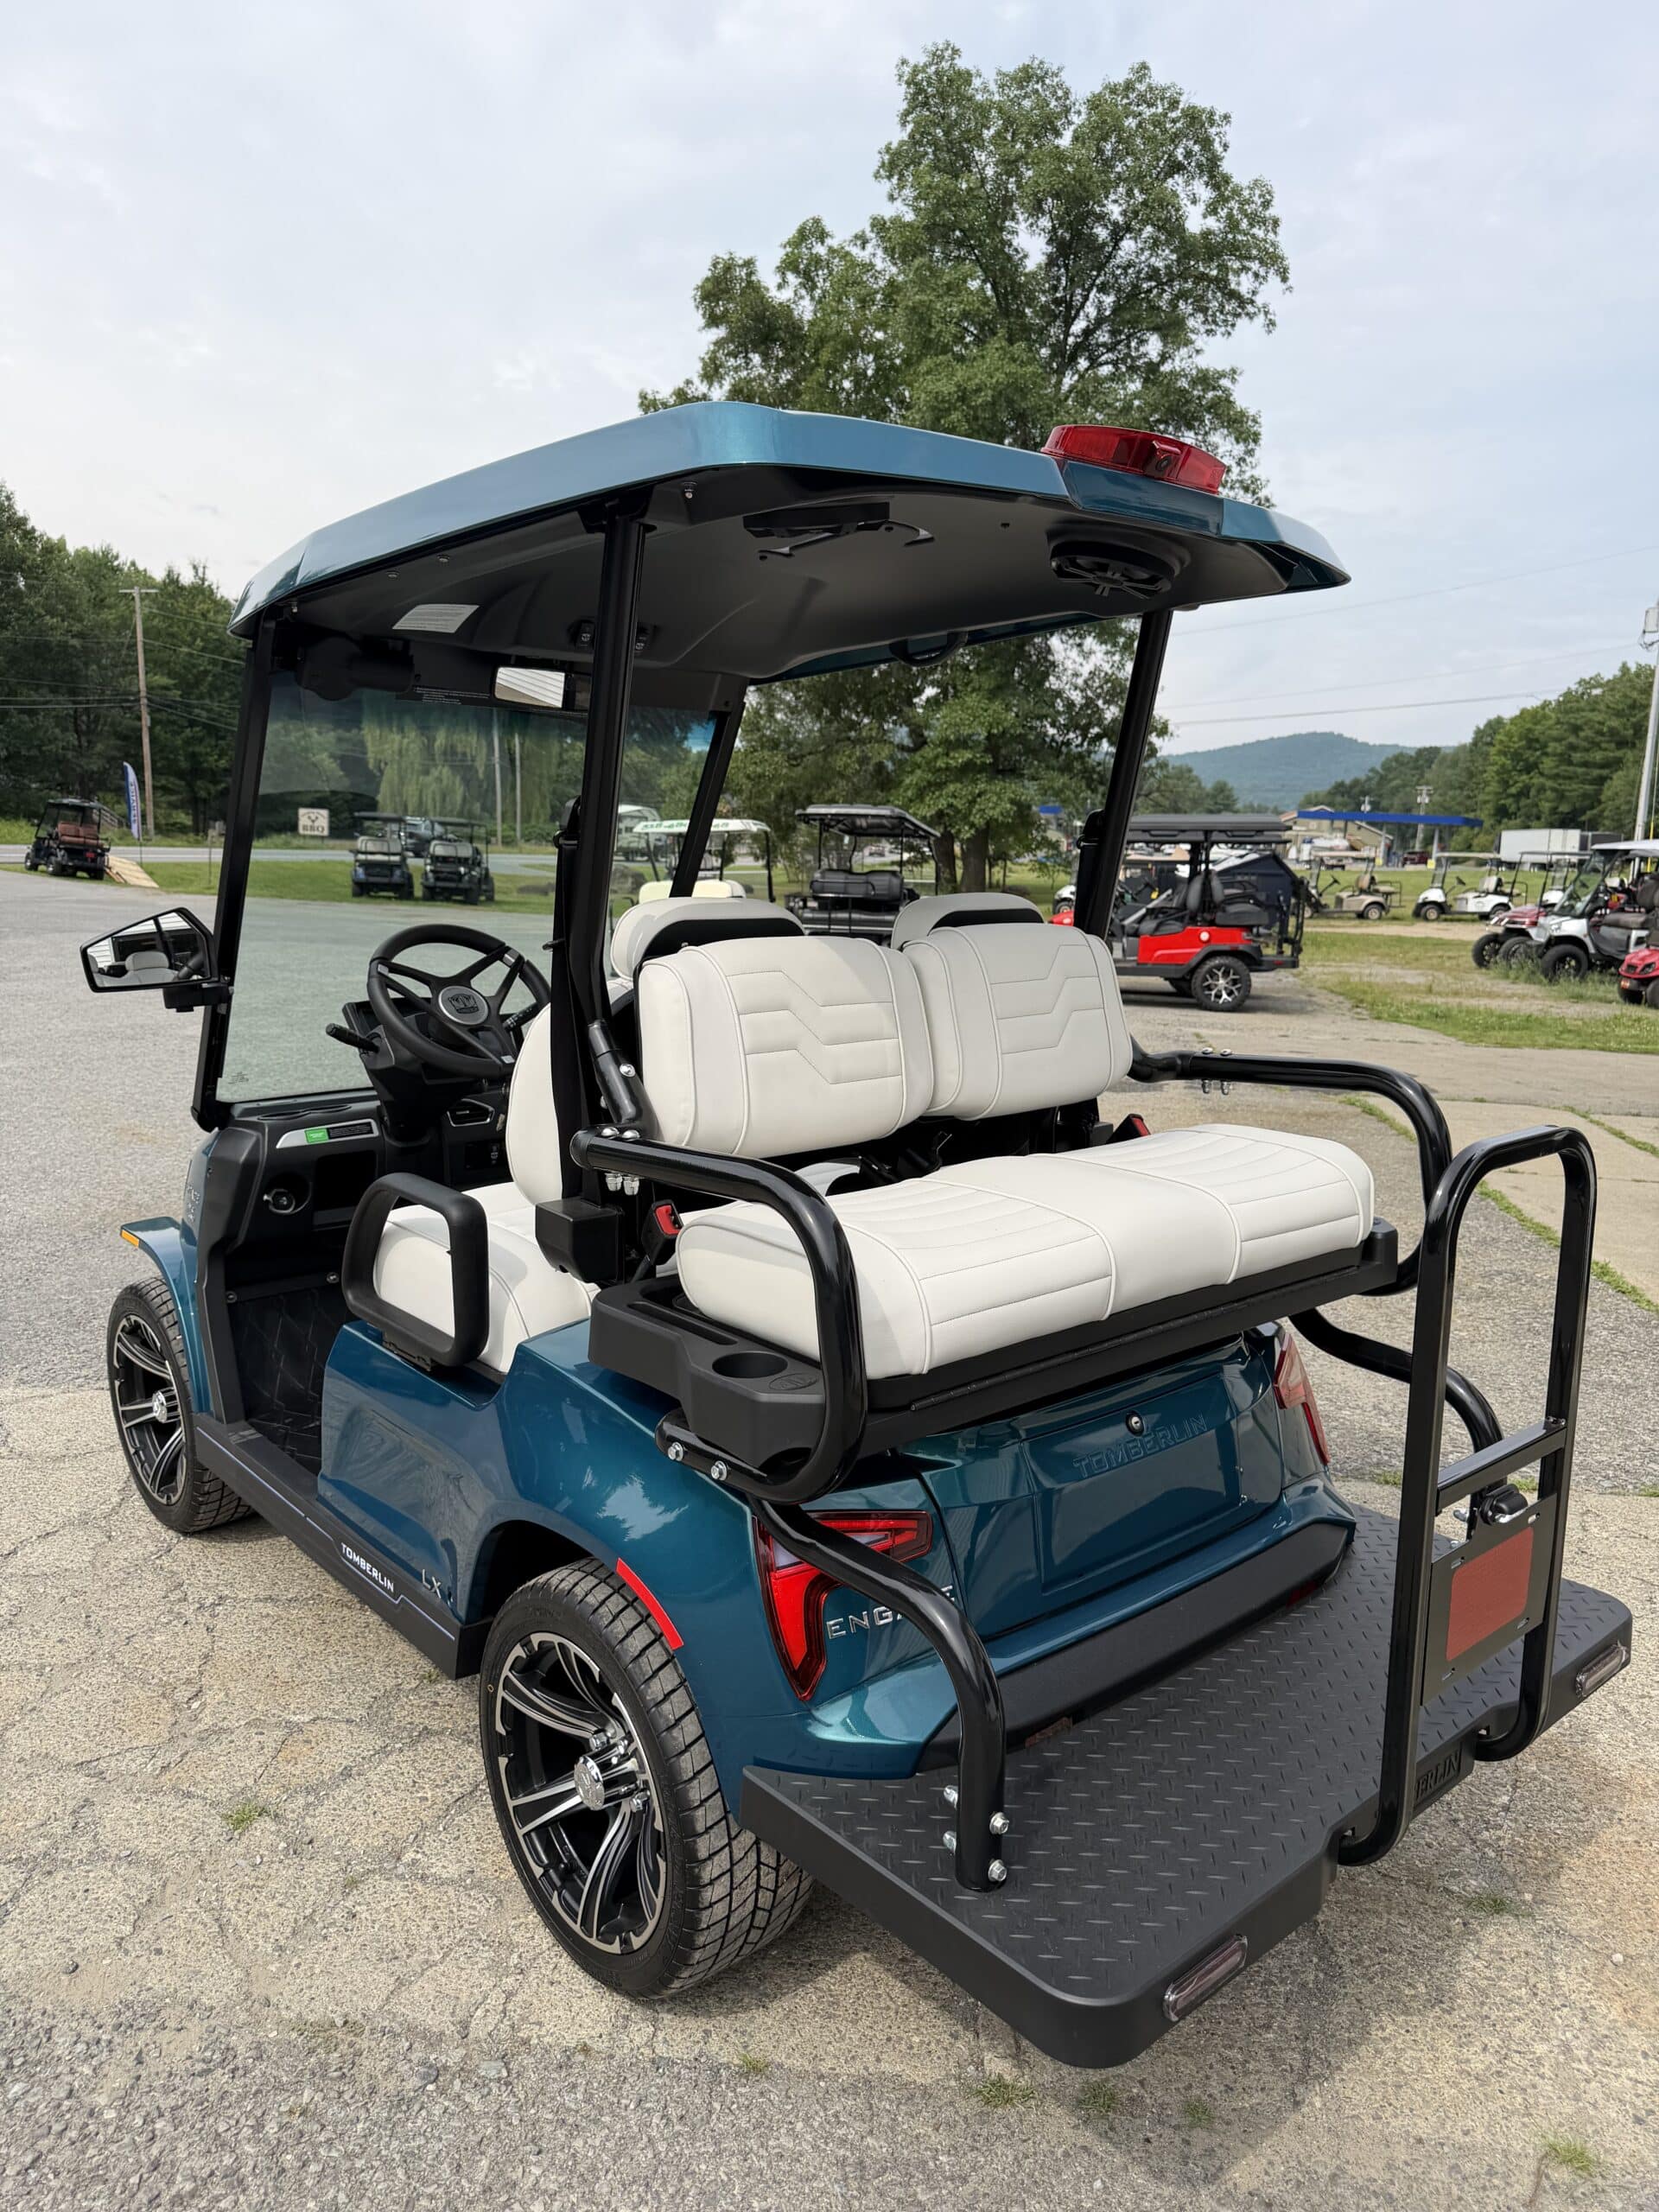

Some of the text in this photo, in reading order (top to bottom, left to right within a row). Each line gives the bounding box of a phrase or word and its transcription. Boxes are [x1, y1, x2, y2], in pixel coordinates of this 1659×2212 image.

[1073, 1414, 1208, 1478] TOMBERLIN
[340, 1542, 395, 1593] TOMBERLIN
[422, 1568, 442, 1599] LX
[1415, 1746, 1462, 1802] ERLIN
